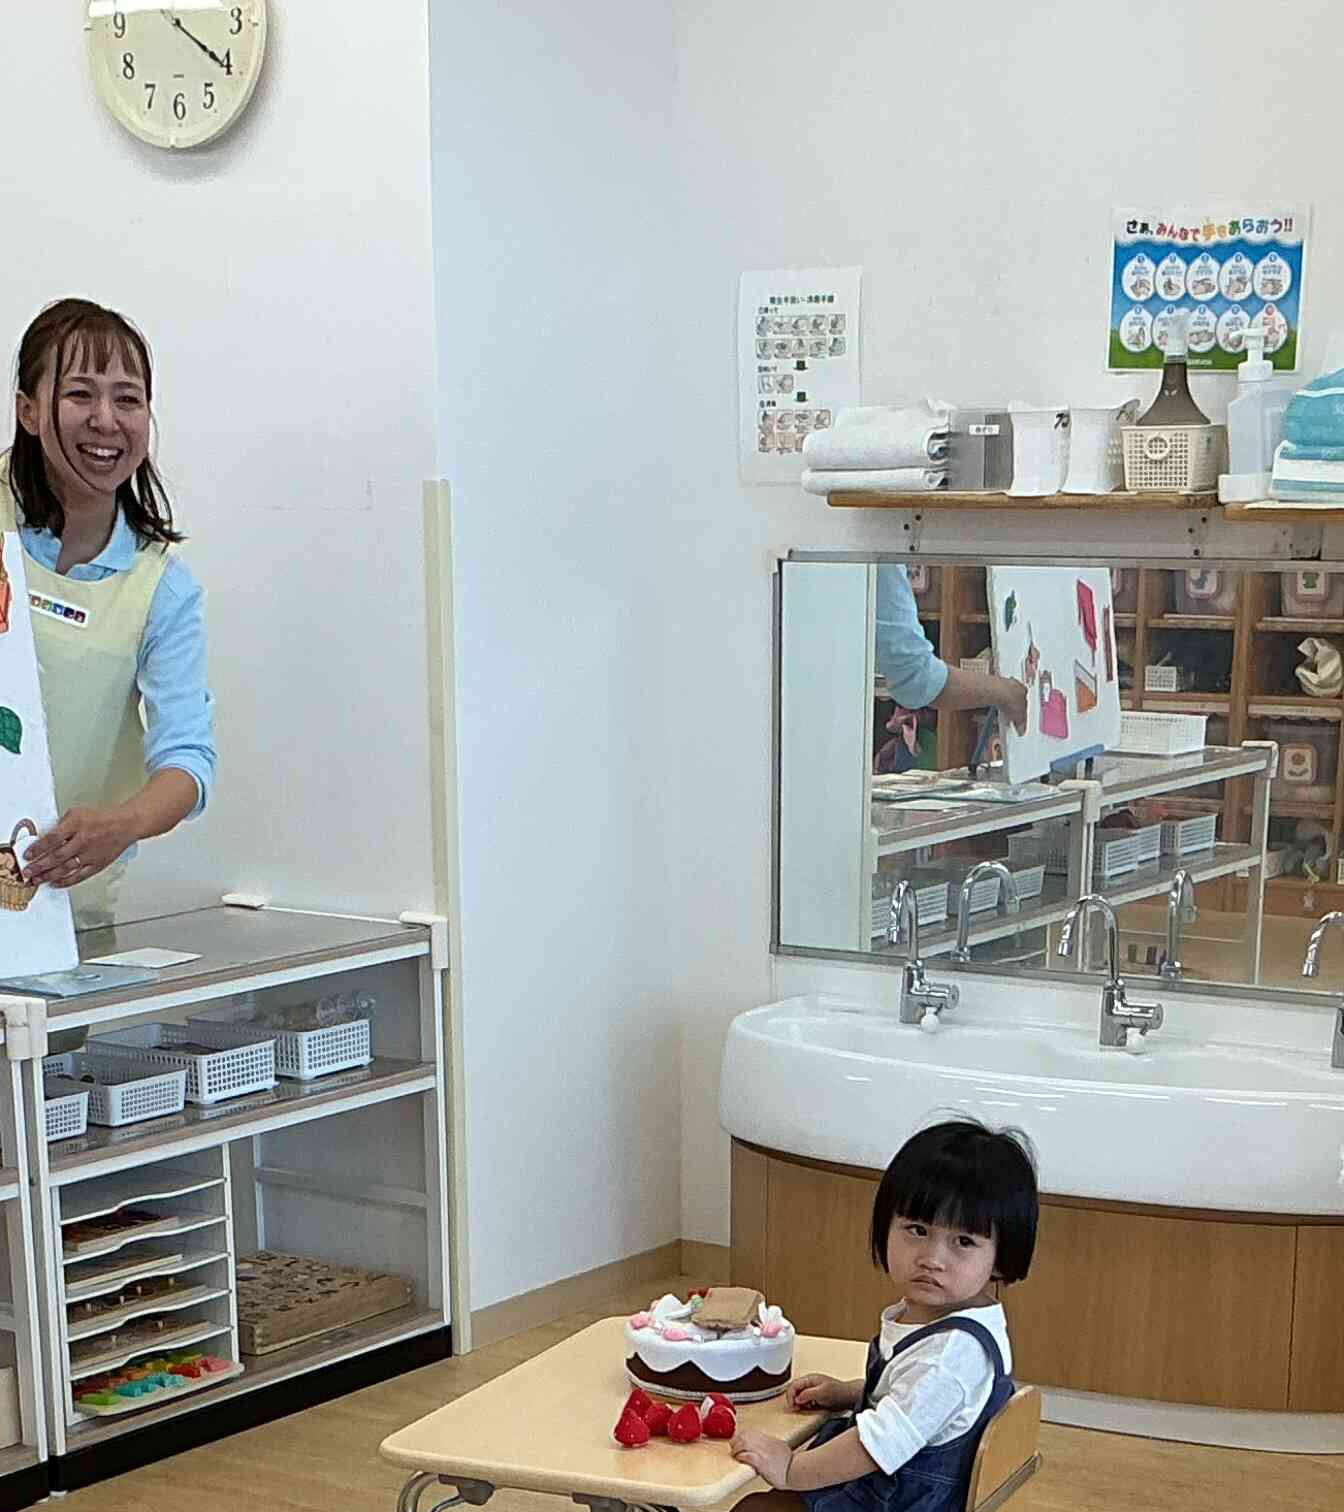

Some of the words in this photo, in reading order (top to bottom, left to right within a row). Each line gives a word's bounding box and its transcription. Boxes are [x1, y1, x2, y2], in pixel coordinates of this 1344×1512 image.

[113, 12, 126, 38] 9
[229, 7, 242, 35] 3
[122, 53, 135, 80] 8
[222, 48, 233, 75] 4
[145, 83, 156, 109] 7
[173, 93, 186, 120] 6
[202, 82, 215, 109] 5
